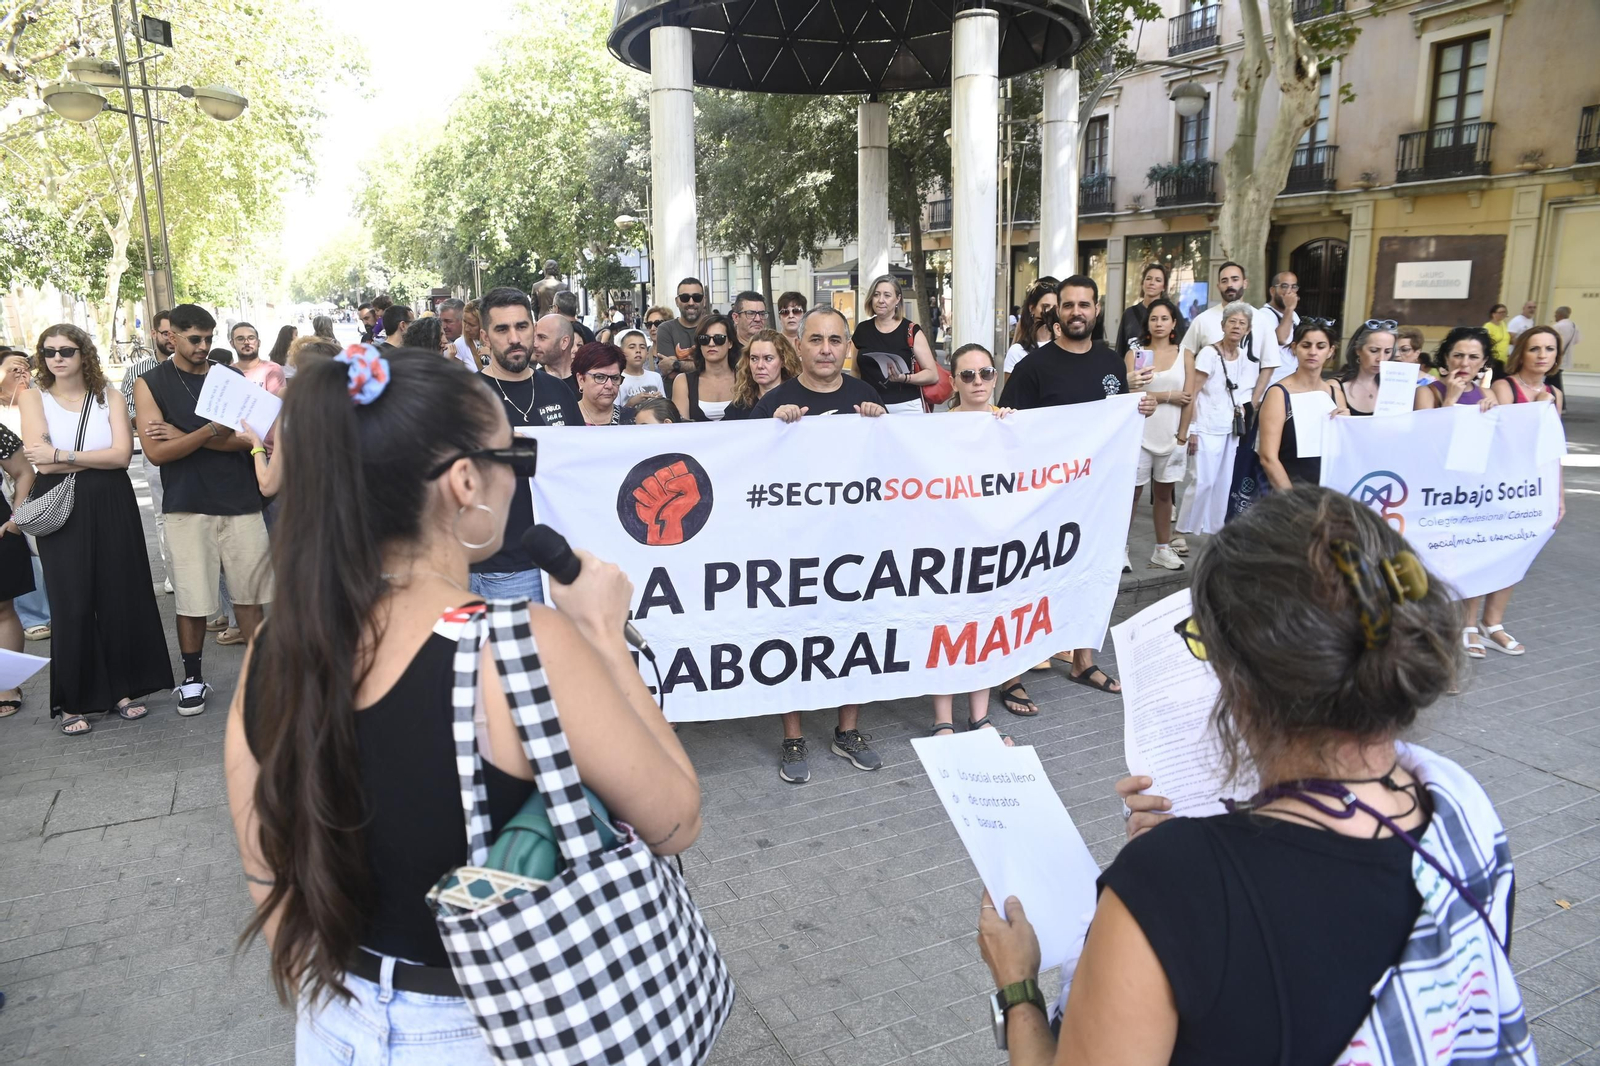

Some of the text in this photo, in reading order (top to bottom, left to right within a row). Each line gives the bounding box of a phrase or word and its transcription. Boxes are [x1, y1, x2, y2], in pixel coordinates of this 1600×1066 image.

[746, 458, 1091, 509] #SECTORSOCIALENLUCHA
[1421, 477, 1542, 508] Trabajo Social
[1418, 508, 1543, 528] Colegio Profesional Córdoba
[1427, 532, 1488, 549] socialmente
[628, 522, 1081, 620] A PRECARIEDAD
[925, 596, 1053, 668] MATA
[957, 768, 1036, 784] Lo social está lleno
[967, 792, 1021, 808] de contratos
[975, 814, 1007, 829] basura.
